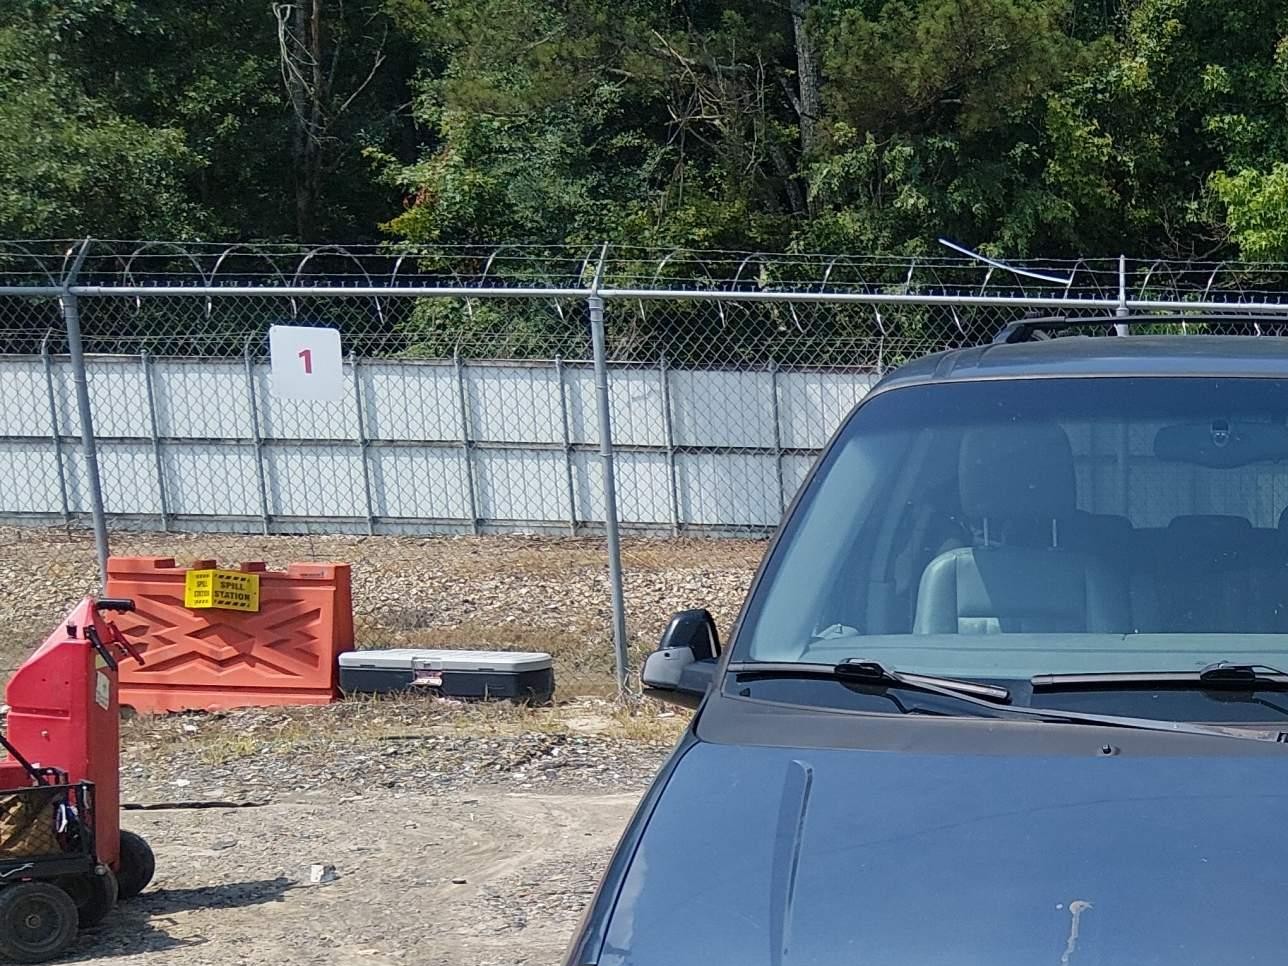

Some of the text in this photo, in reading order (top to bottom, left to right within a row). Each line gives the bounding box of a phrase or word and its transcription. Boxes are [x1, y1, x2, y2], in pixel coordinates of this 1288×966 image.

[298, 349, 312, 374] 1
[220, 581, 245, 591] SPILL
[214, 590, 250, 600] STATION
